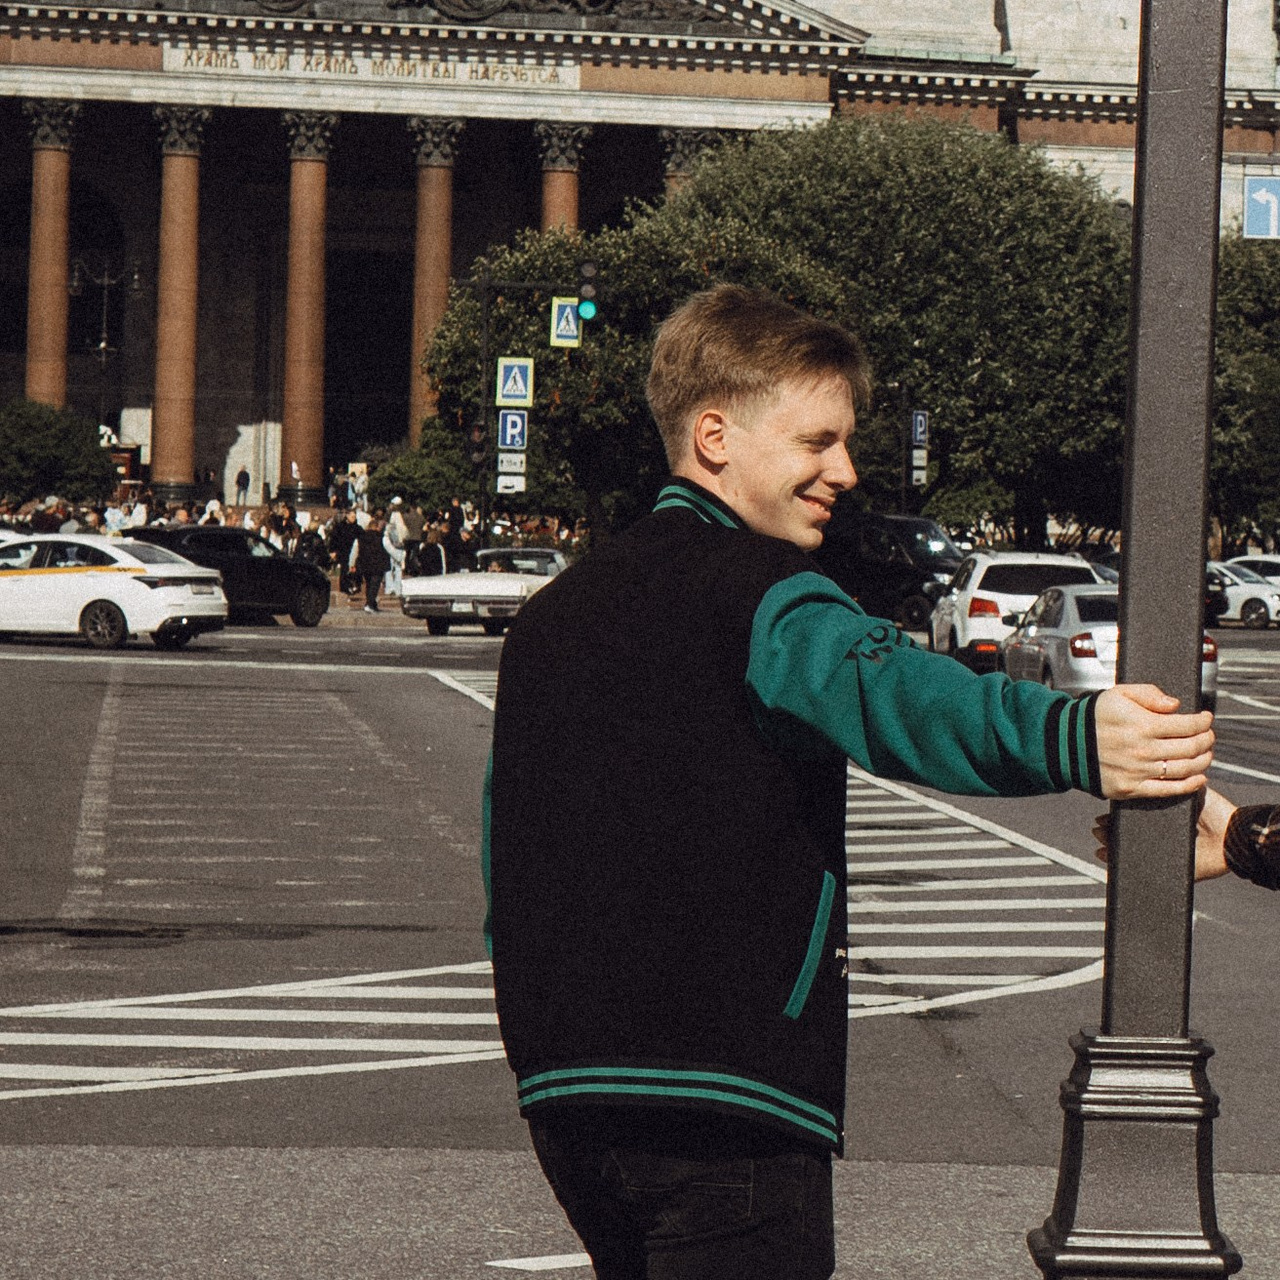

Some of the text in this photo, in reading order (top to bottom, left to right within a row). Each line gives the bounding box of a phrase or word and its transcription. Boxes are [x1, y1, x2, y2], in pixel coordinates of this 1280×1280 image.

[184, 49, 239, 68] ХРАМЪ
[302, 54, 358, 73] ХРАМЪ
[371, 59, 456, 78] МОЛИТВЫ
[506, 414, 522, 445] P
